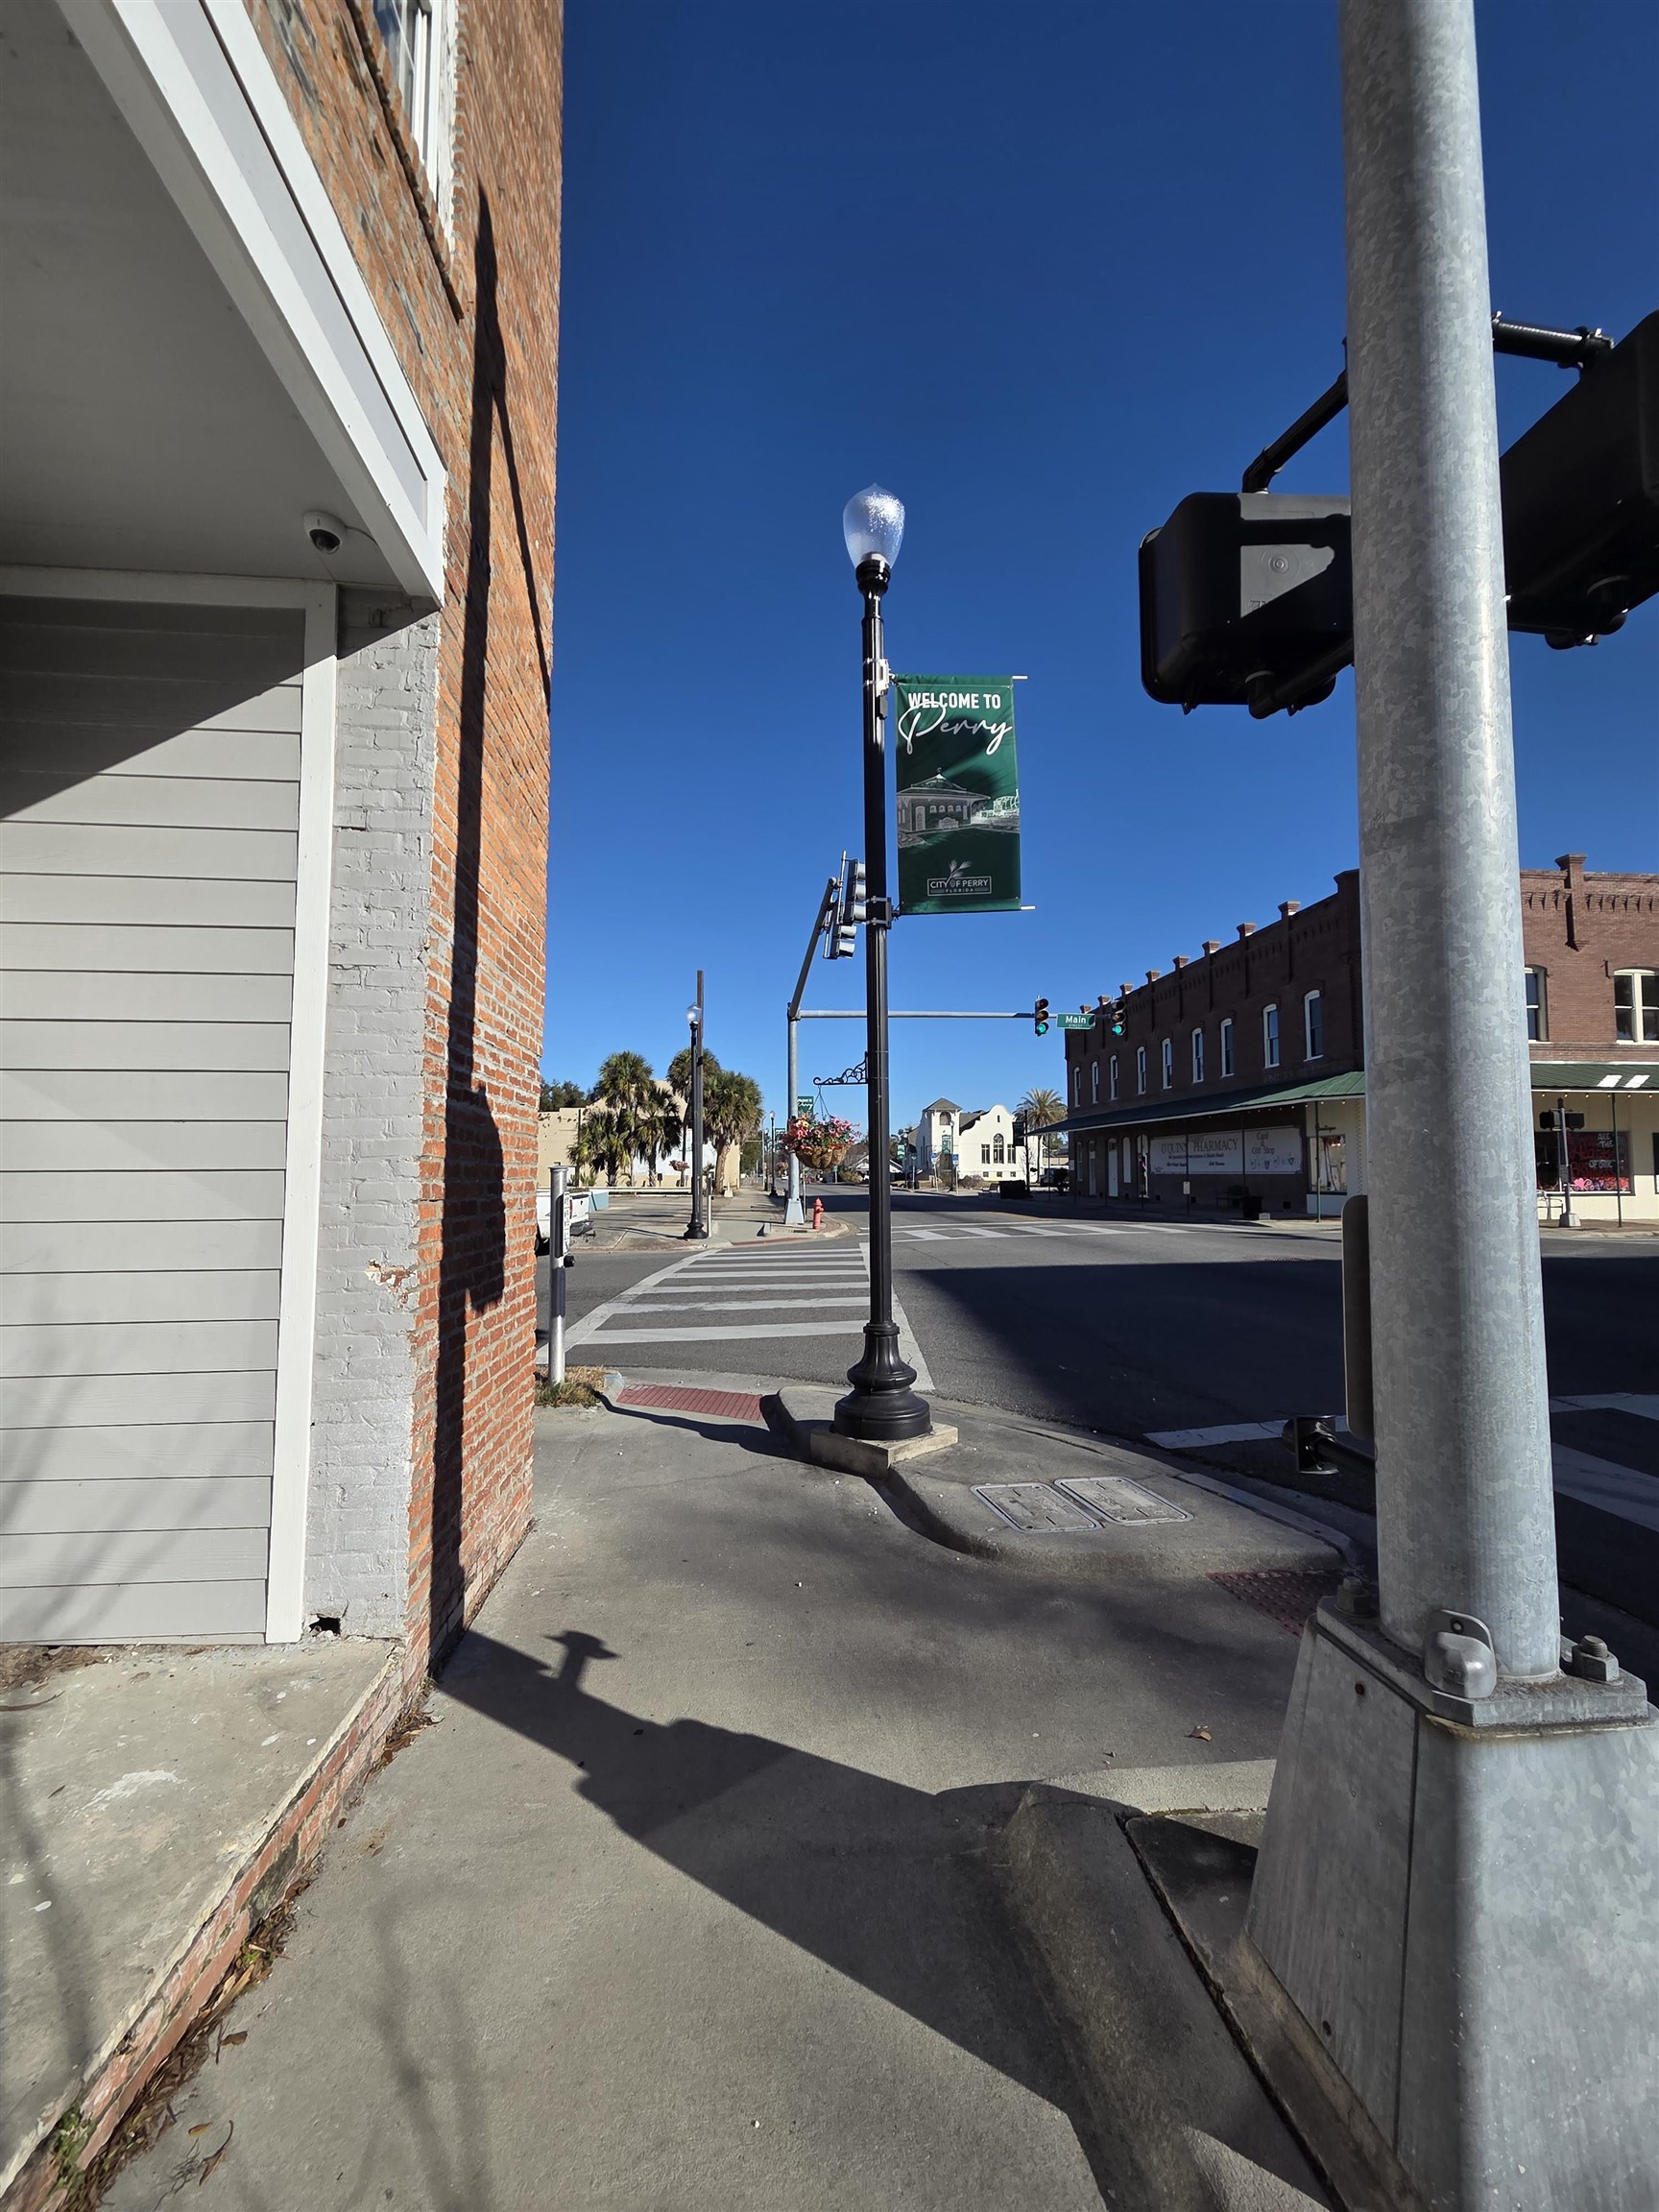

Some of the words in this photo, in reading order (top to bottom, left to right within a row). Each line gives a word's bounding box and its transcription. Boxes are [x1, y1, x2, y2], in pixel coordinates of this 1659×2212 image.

[907, 692, 980, 709] WELCOME
[983, 693, 1001, 709] TO
[898, 701, 1013, 756] Perry
[929, 880, 948, 889] CITY
[950, 878, 961, 888] OF
[962, 878, 988, 887] PERRY
[1065, 1015, 1086, 1023] Main
[1193, 1138, 1238, 1152] PHARMACY
